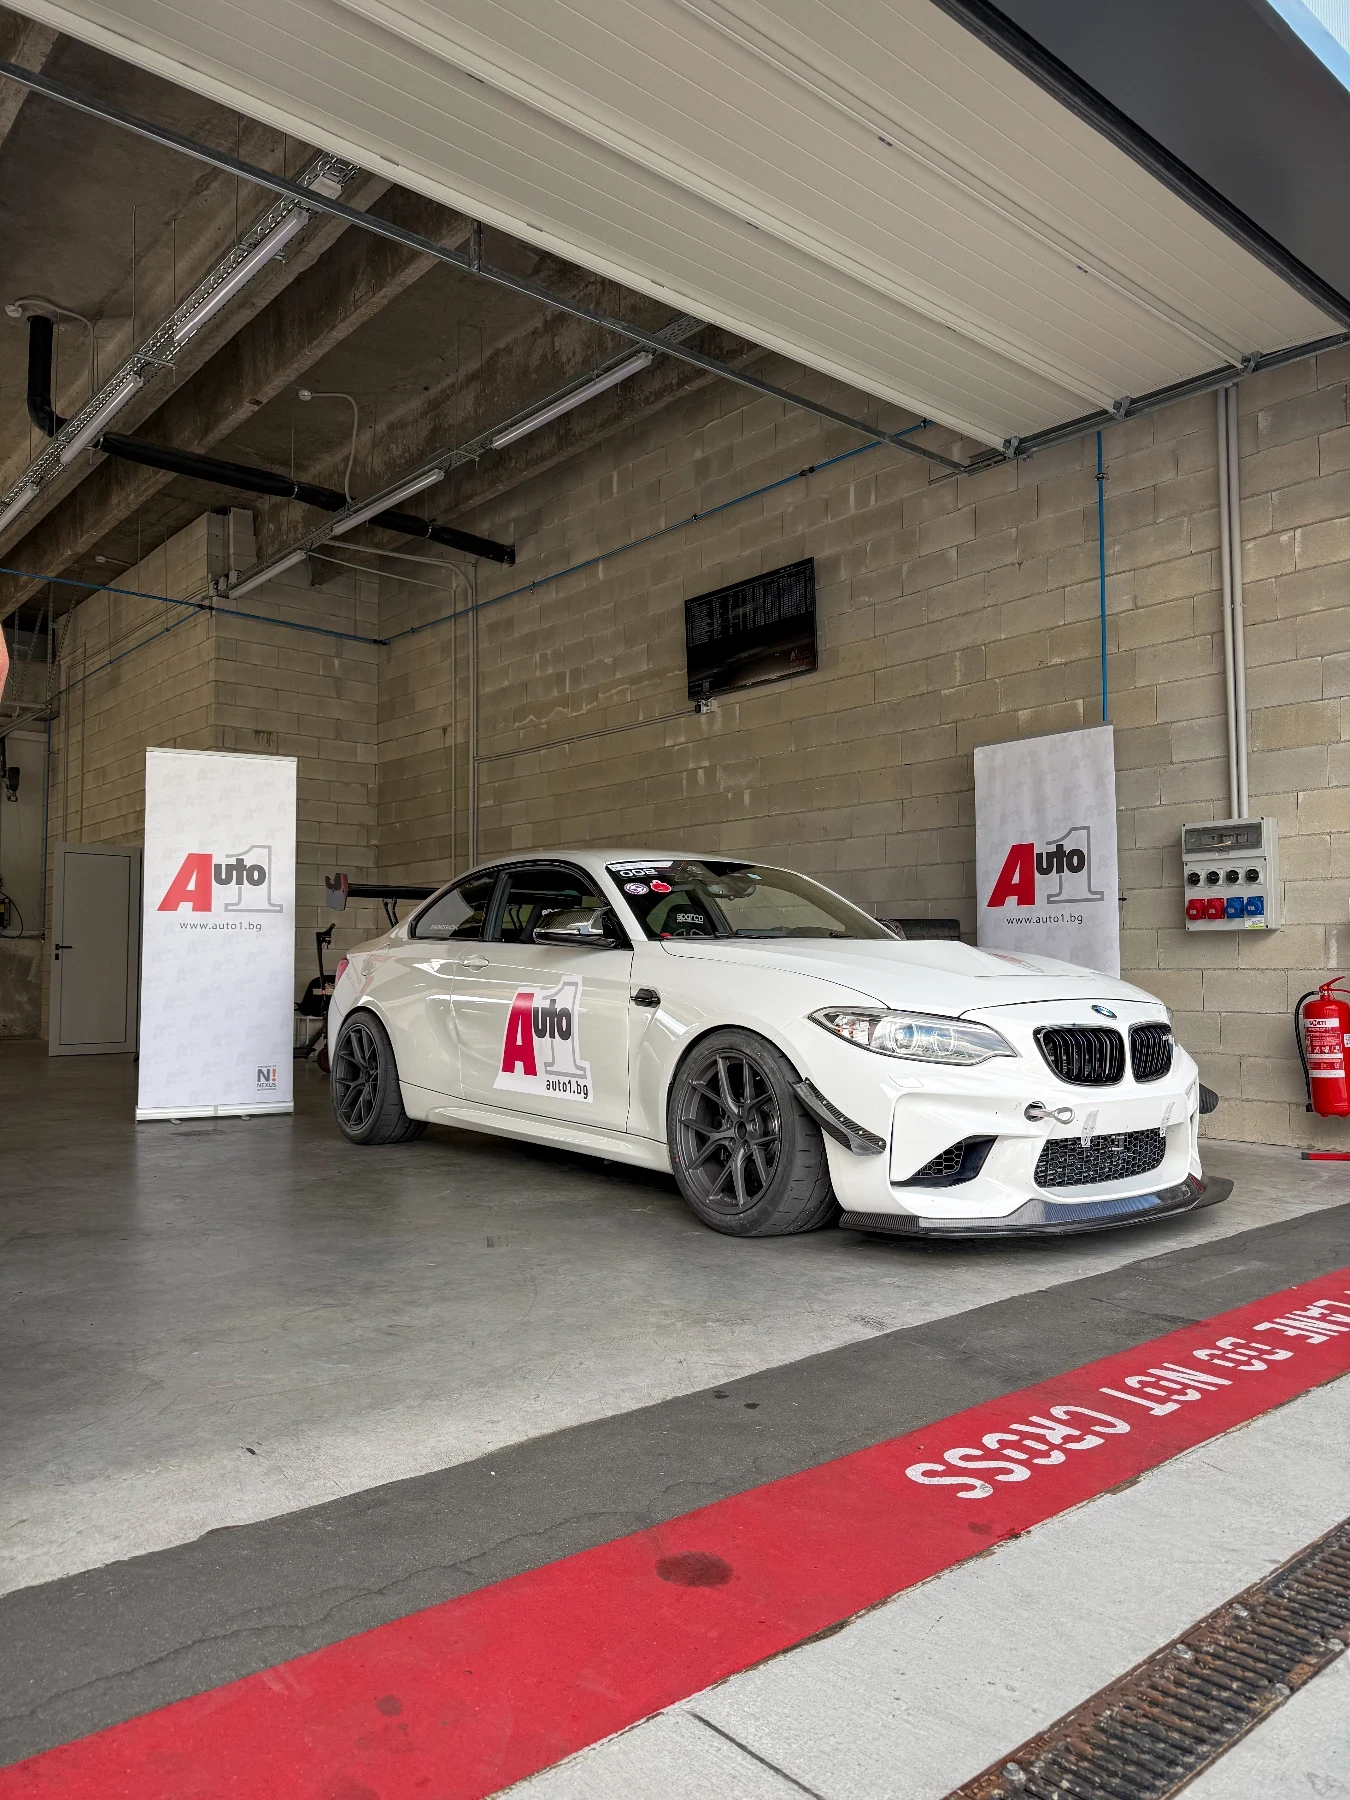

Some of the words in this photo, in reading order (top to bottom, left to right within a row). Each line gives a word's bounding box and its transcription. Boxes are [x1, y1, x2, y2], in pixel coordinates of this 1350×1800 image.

[179, 922, 262, 932] www.auto1.bg
[676, 912, 704, 923] sparco
[1006, 913, 1083, 925] www.auto1.bg
[545, 1079, 589, 1100] auto1.bg
[1193, 1336, 1295, 1371] DO
[1099, 1362, 1234, 1416] NOT
[904, 1405, 1131, 1499] CROSS
